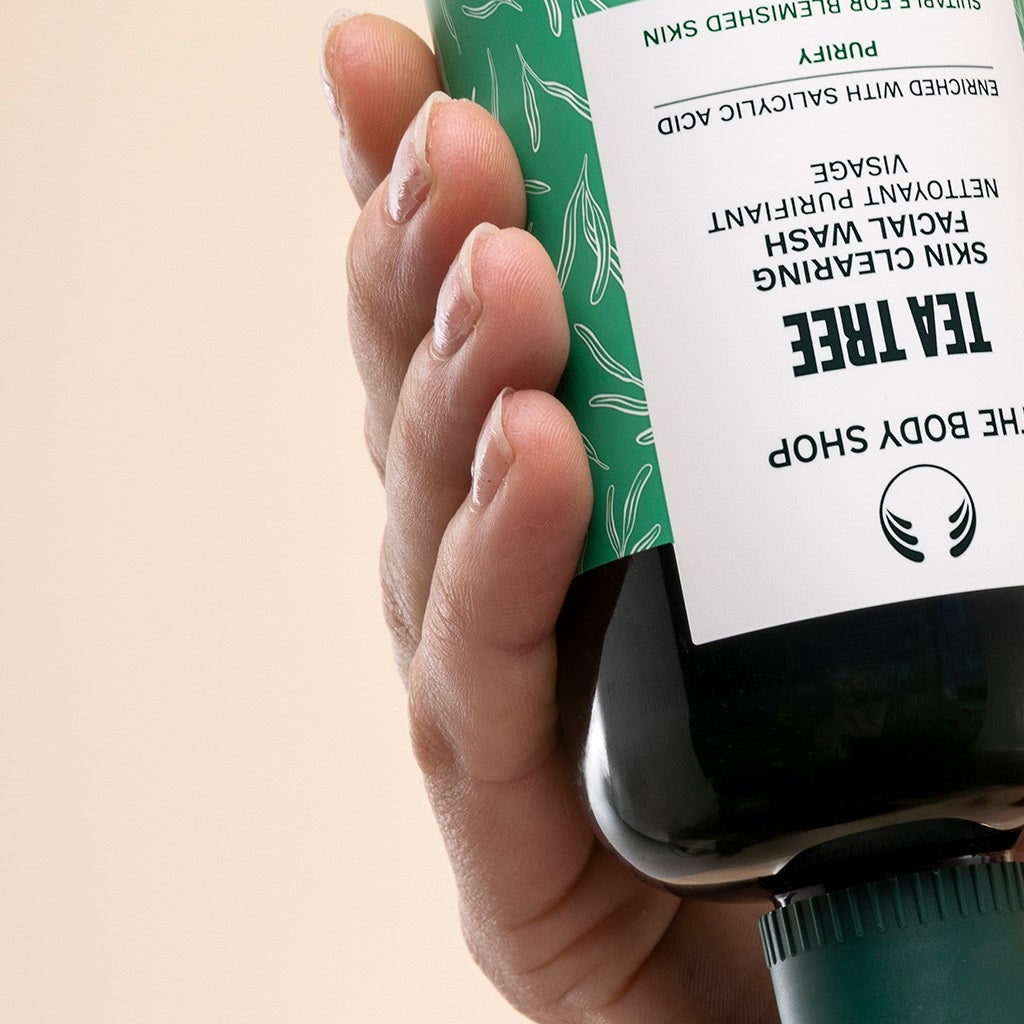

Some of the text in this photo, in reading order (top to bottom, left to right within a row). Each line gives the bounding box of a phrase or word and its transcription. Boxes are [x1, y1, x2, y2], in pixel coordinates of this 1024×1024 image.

[706, 0, 841, 32] BLEMISHED
[850, 0, 891, 12] FOR
[643, 20, 698, 47] SKIN
[799, 40, 878, 65] PURIFY
[658, 78, 999, 135] ENRICHED WITH SALICYLIC ACID
[810, 154, 908, 184] VISAGE
[708, 178, 999, 234] NETTOYANT PURIFIANT
[764, 210, 969, 257] FACIAL WASH
[753, 241, 988, 292] SKIN CLEARING
[782, 291, 993, 378] TEA TREE
[768, 425, 868, 468] SHOP
[880, 411, 970, 450] BODY
